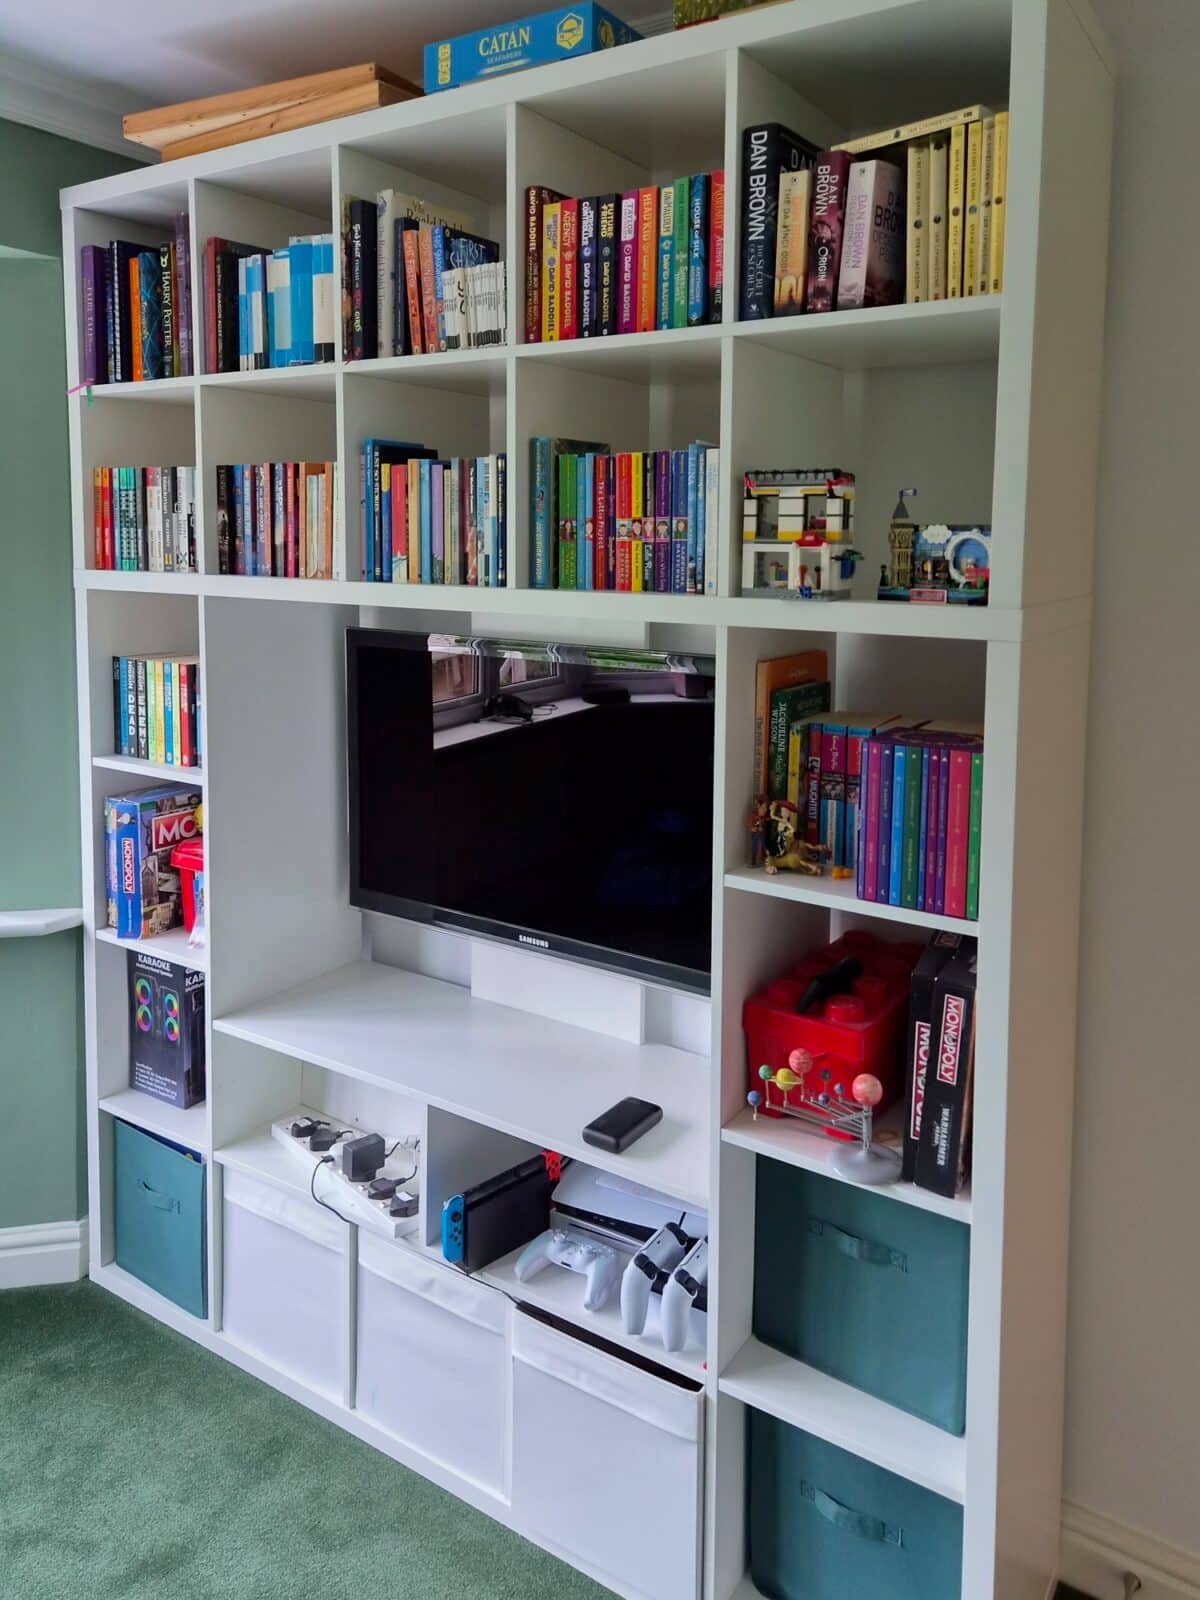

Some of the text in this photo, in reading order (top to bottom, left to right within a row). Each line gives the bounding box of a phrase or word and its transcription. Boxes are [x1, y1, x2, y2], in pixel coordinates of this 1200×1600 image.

[478, 26, 530, 57] CATAN
[529, 190, 537, 214] DAVID
[748, 131, 768, 241] DAN BROWN
[815, 165, 830, 215] BROWN
[829, 175, 839, 204] DAN
[856, 194, 868, 221] DAN
[529, 216, 537, 252] BADDIEL
[642, 193, 652, 241] HEAD KID
[693, 198, 701, 229] HOUSE
[458, 238, 486, 261] FIRST
[817, 246, 829, 282] ORIGIN
[852, 223, 865, 269] BROWN
[161, 271, 172, 347] HARRY POTTER
[547, 267, 555, 333] DAVID BADDIEL
[582, 262, 591, 328] DAVID BADDIEL
[623, 256, 632, 323] DAVID BADDIEL
[688, 457, 696, 486] LUNA
[777, 703, 787, 752] JACQUELINE
[808, 779, 817, 819] NAUGHTIEST
[124, 840, 135, 893] MONOPOLY
[138, 954, 171, 971] KARAOKE
[519, 934, 549, 948] SAMSUNG
[940, 999, 961, 1081] MONOPOLY
[936, 1108, 950, 1167] WARHAMMER
